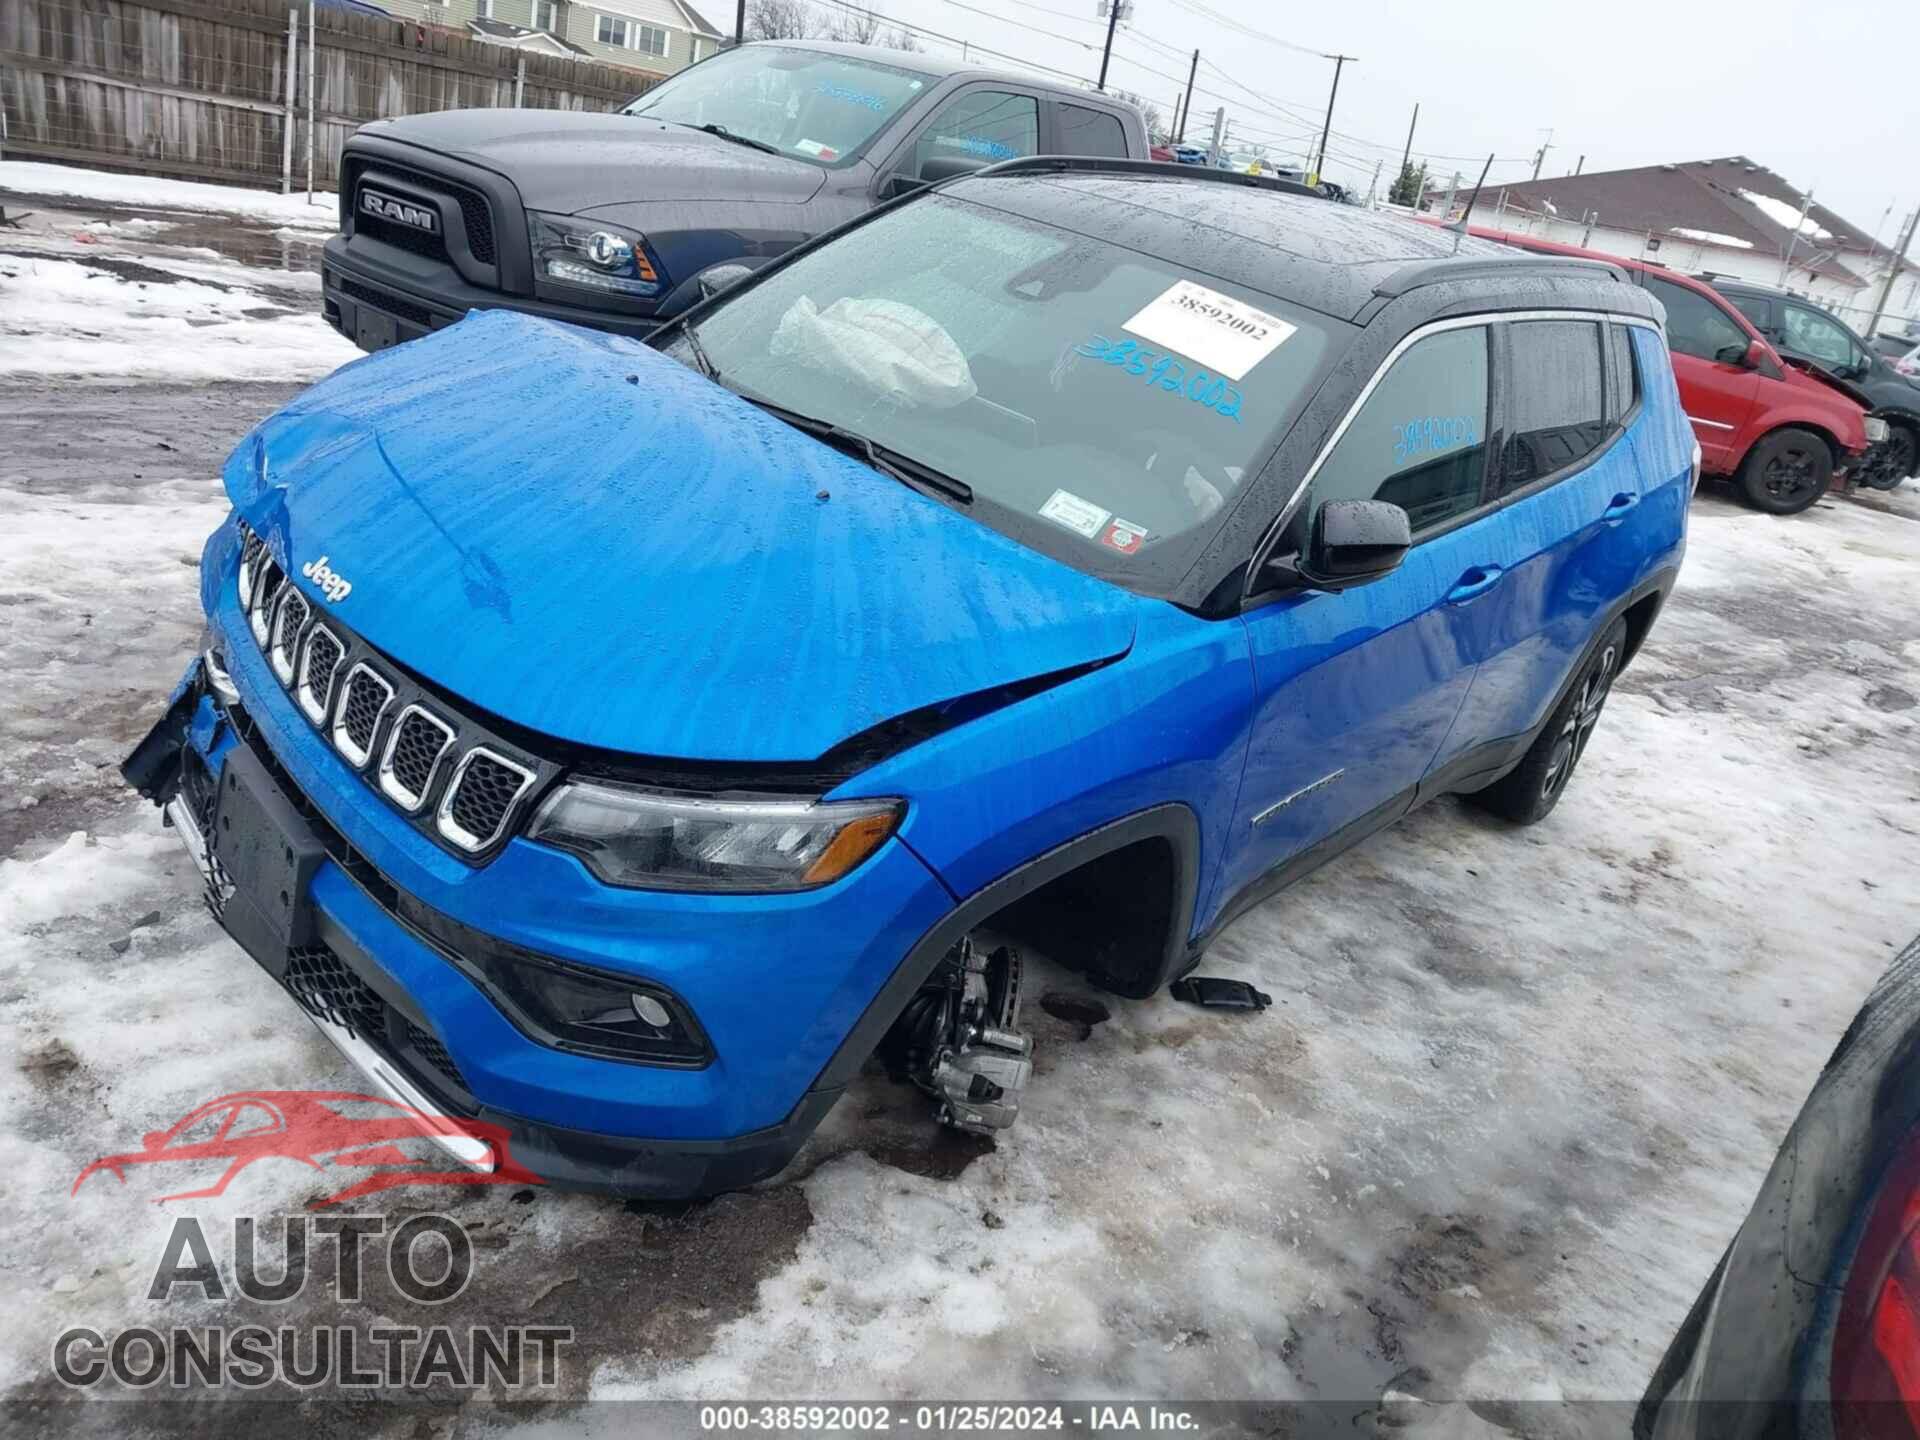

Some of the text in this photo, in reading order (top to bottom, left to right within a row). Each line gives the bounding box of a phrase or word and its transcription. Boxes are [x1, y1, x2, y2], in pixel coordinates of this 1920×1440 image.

[364, 194, 431, 229] RAM
[1170, 295, 1268, 341] 38592002
[303, 555, 352, 603] Jeep
